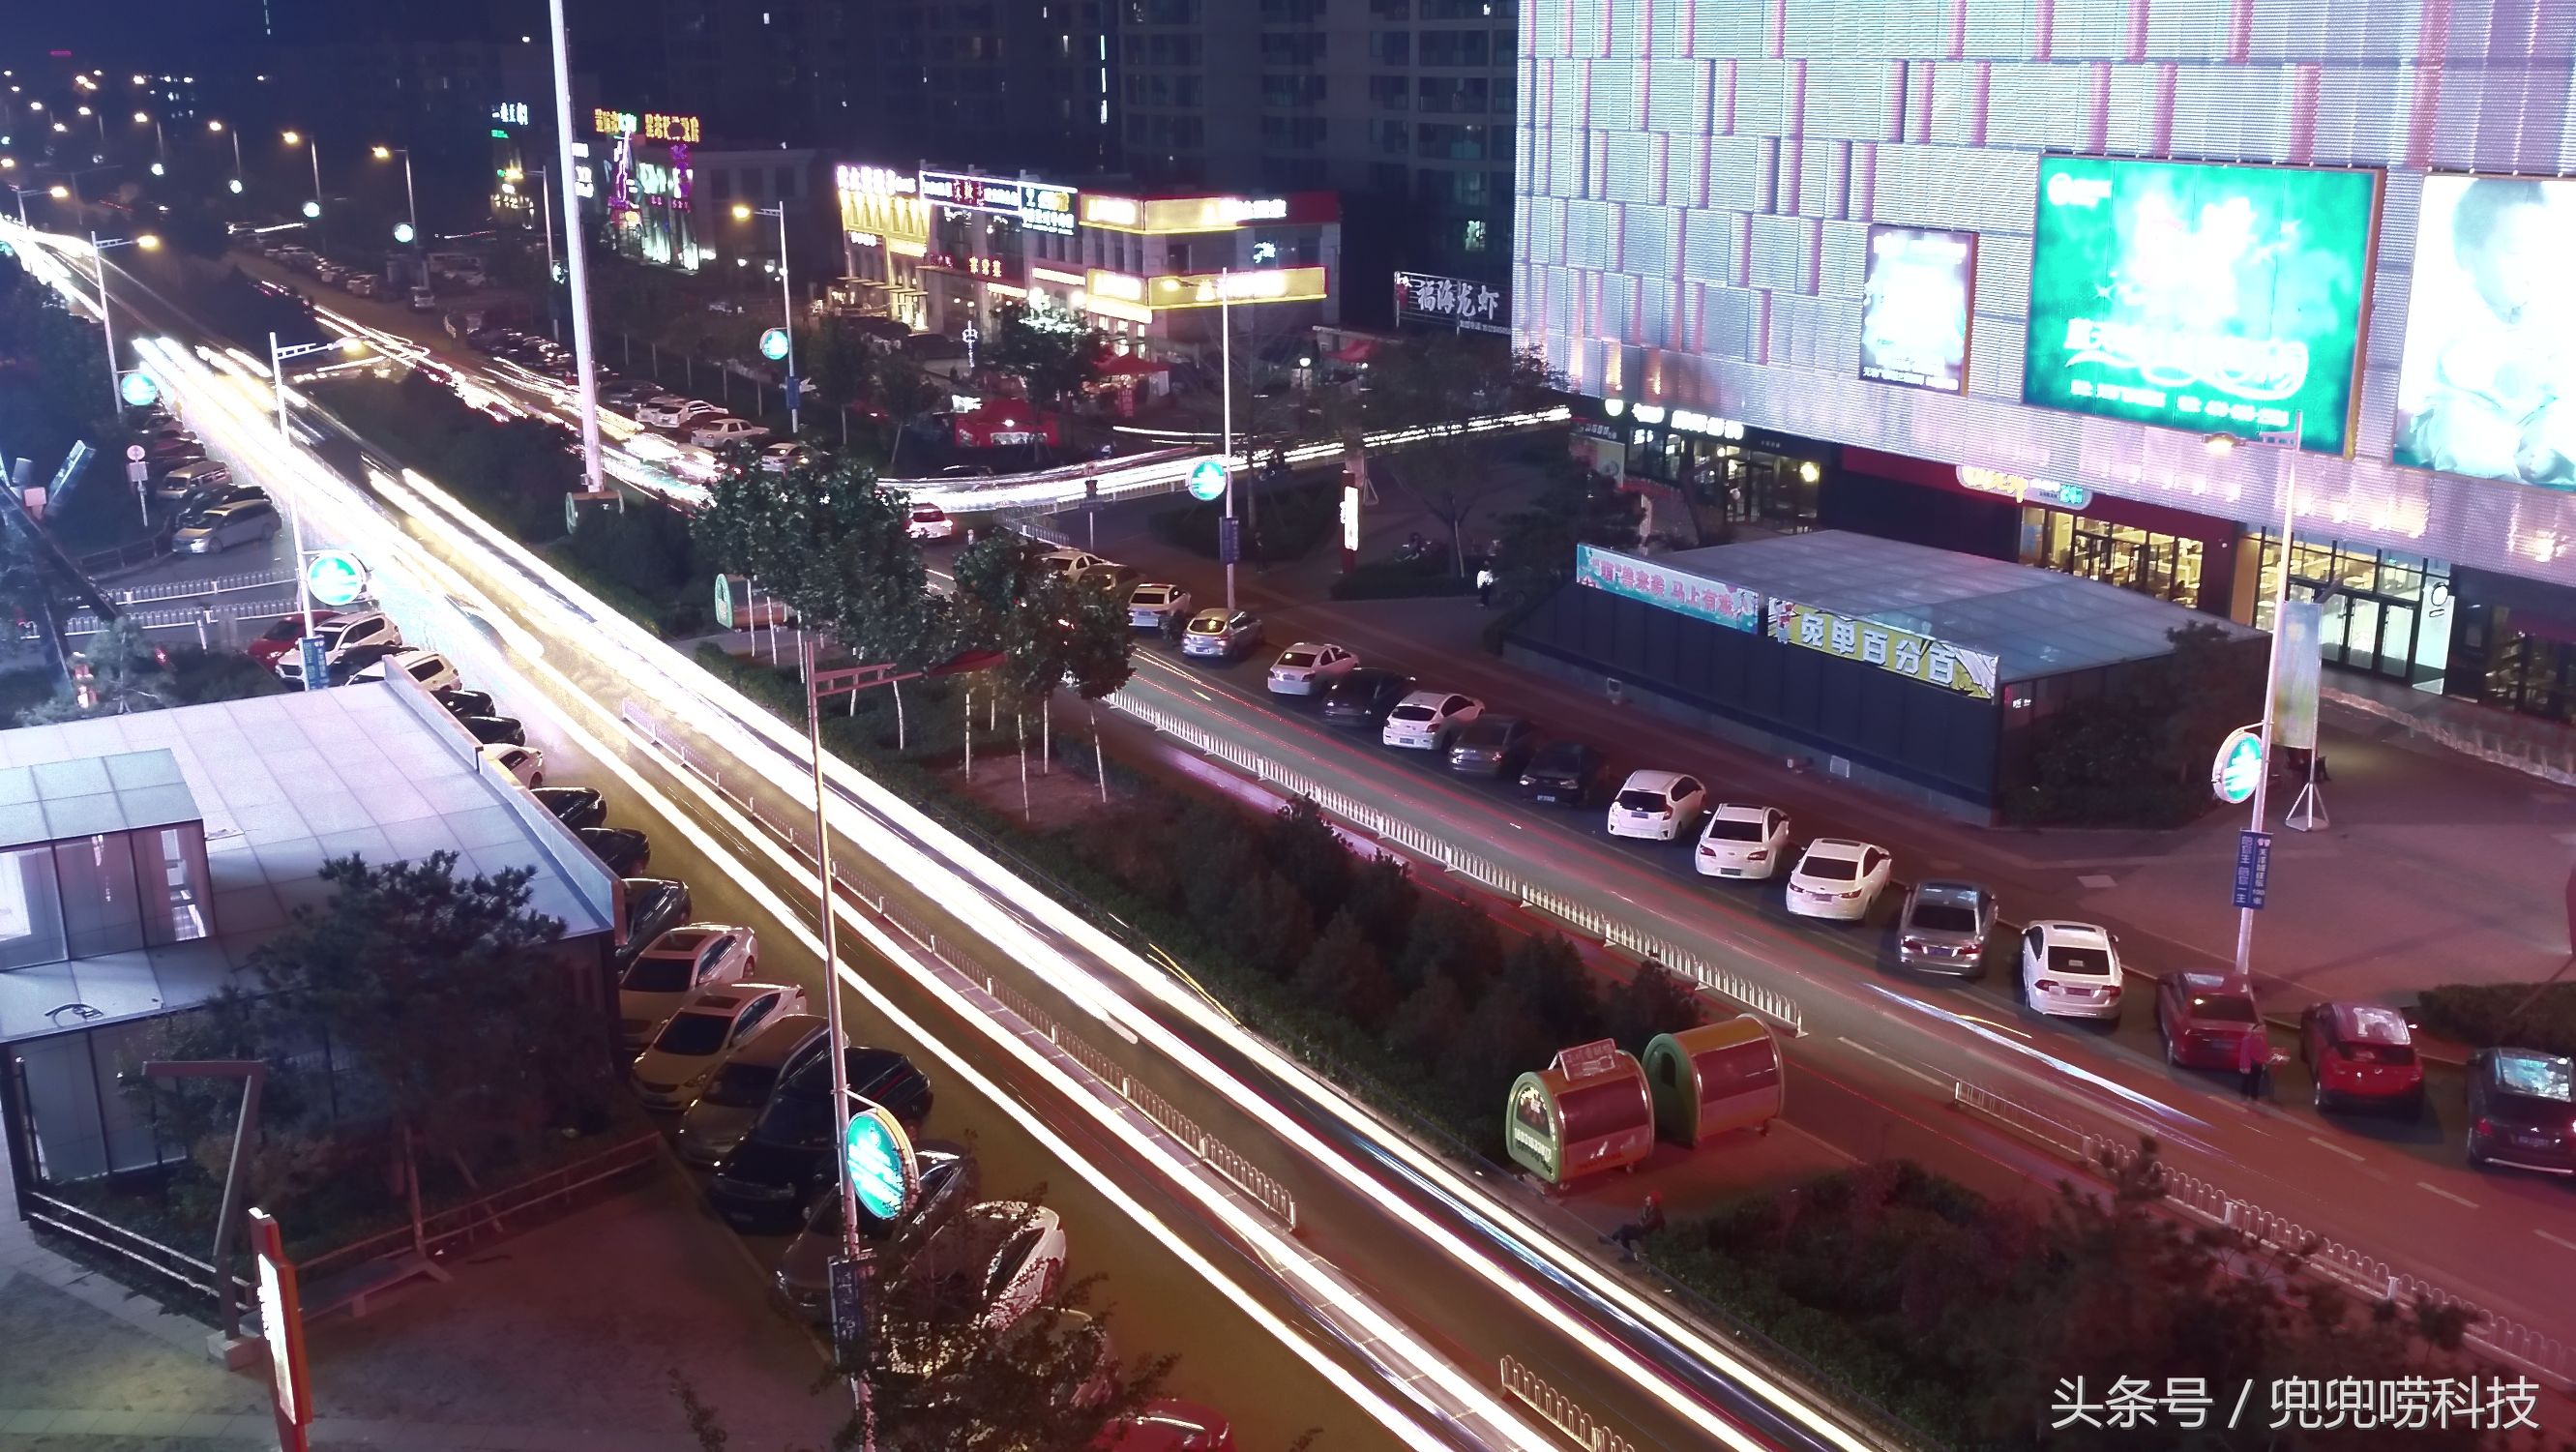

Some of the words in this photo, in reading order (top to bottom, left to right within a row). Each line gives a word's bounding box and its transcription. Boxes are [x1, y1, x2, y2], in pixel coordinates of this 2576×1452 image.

[1800, 611, 1957, 687] 免单百分百
